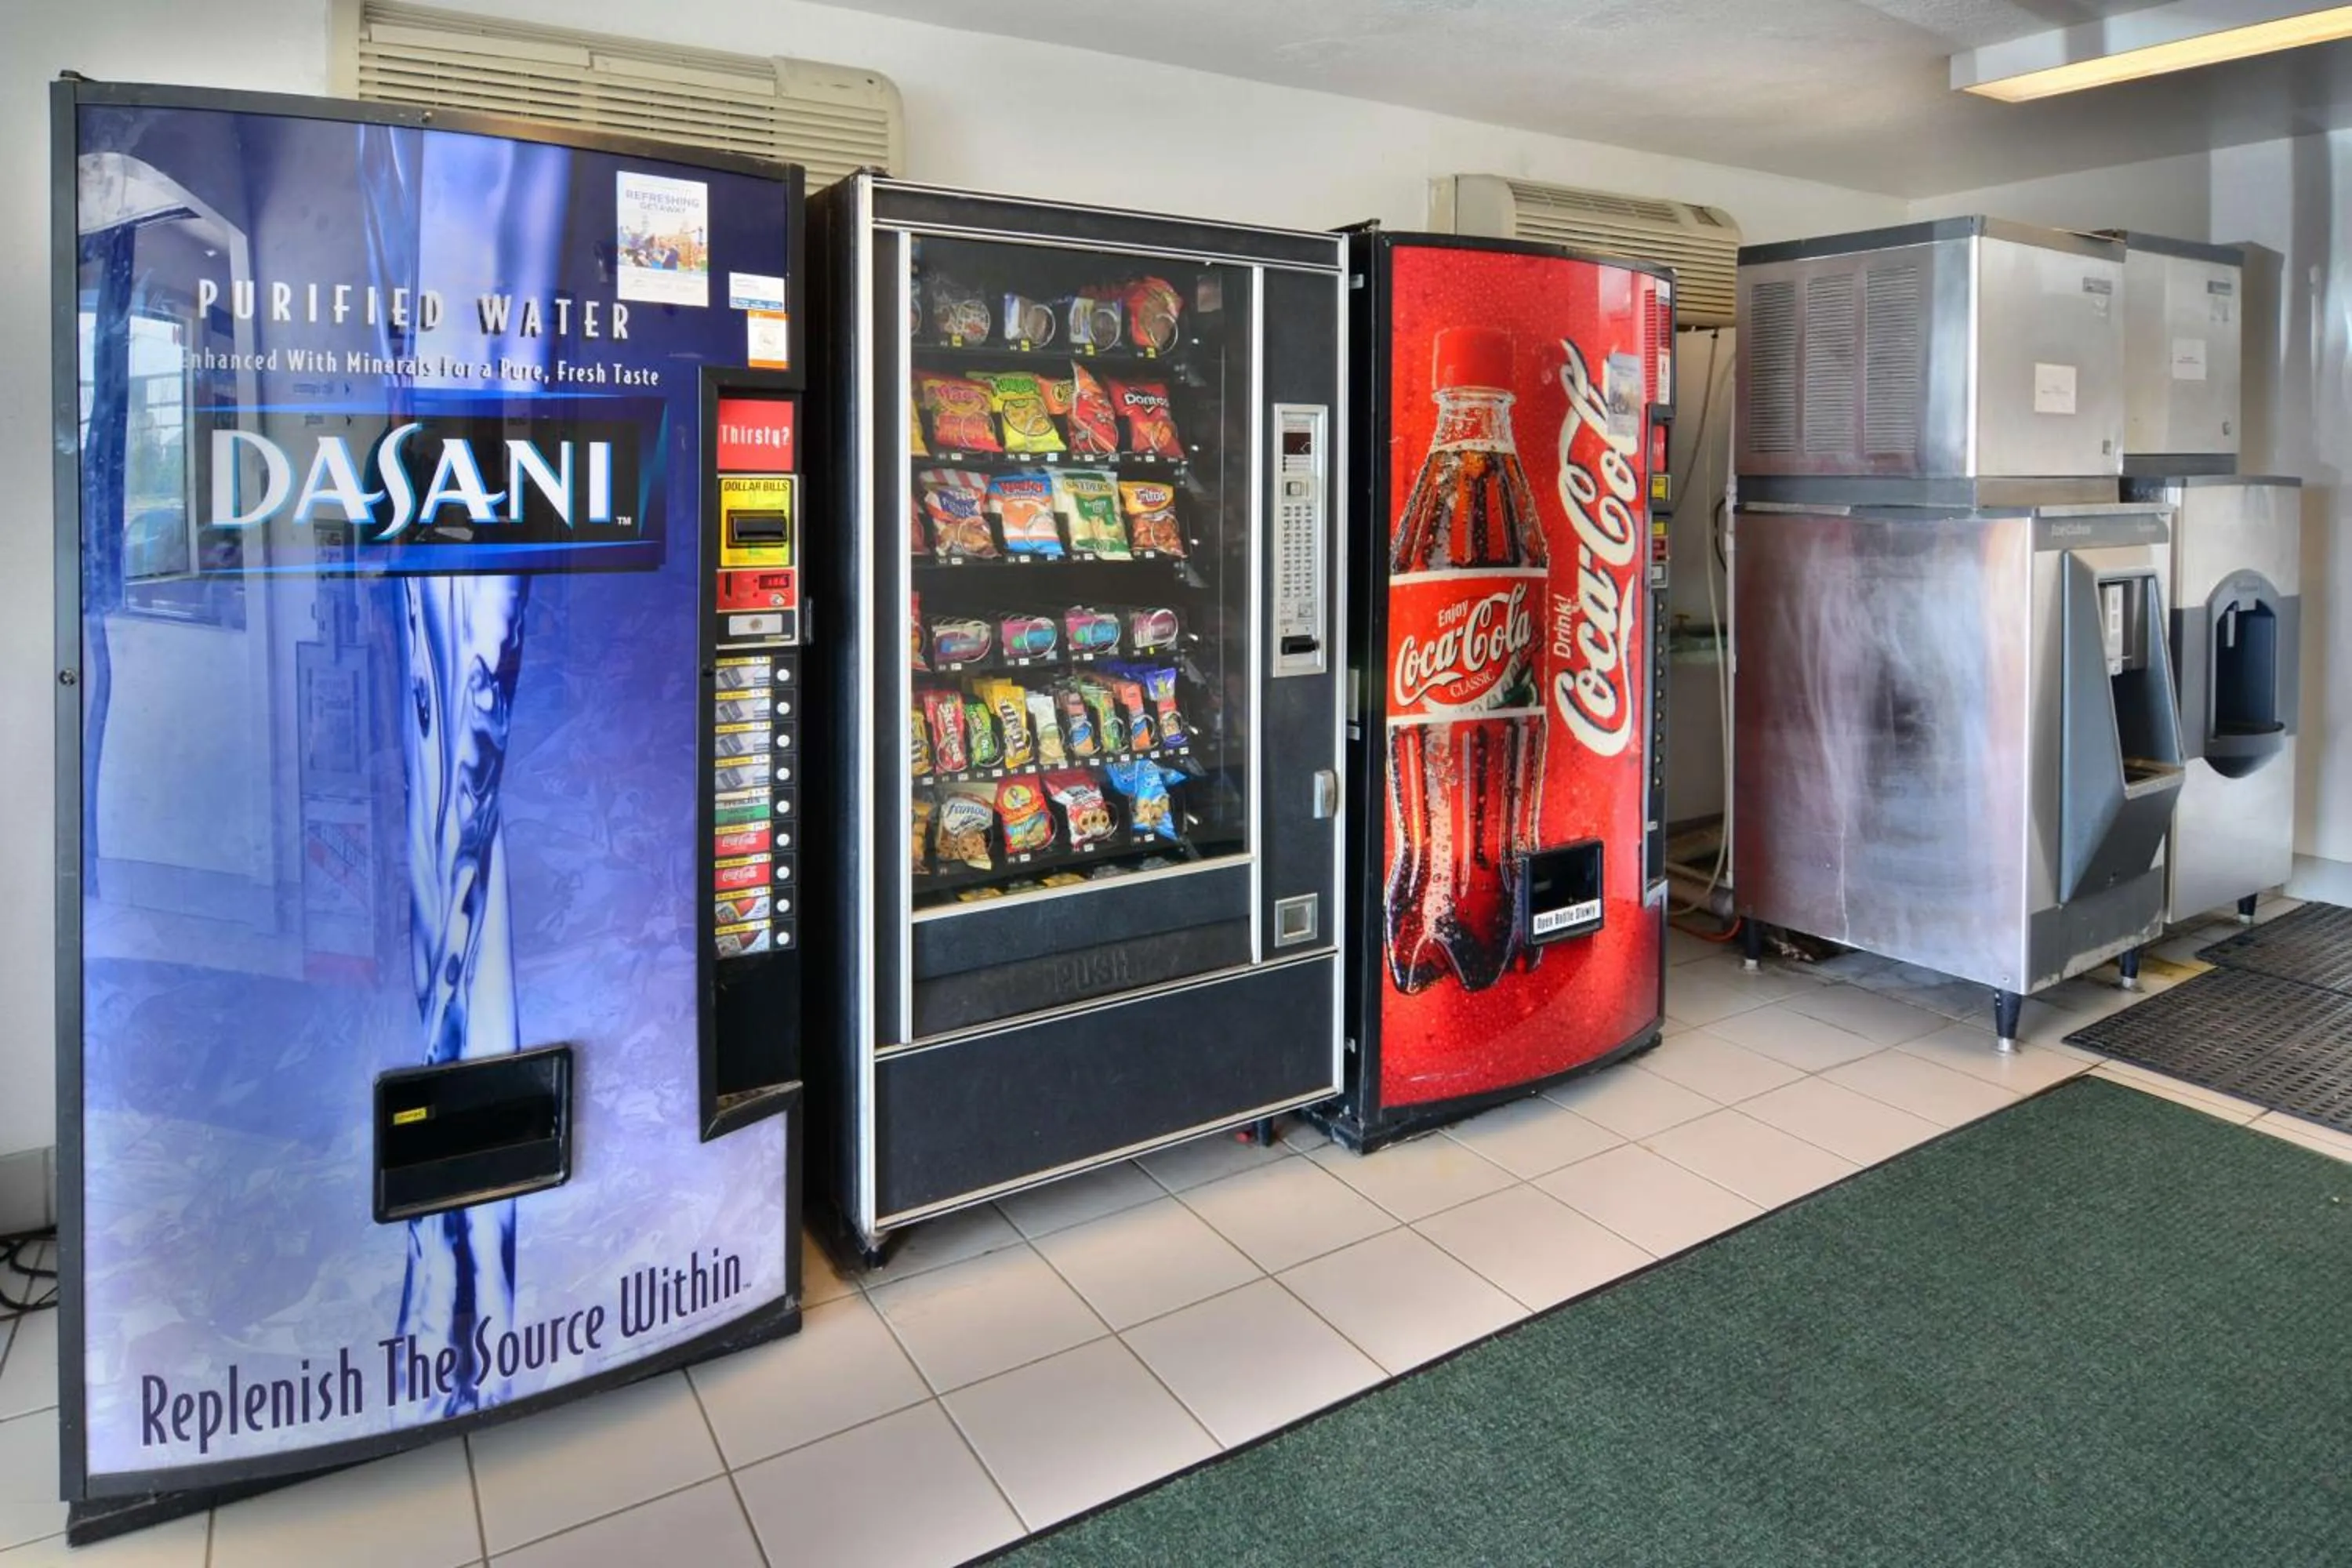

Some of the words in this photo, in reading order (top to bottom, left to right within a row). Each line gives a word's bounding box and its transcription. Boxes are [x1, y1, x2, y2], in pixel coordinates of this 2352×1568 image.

[626, 189, 699, 209] REFRESHING
[640, 202, 686, 214] GETAWAY
[198, 279, 445, 331] PURIFIED
[477, 294, 630, 340] WATER
[181, 347, 278, 372] Enhanced
[287, 348, 338, 373] With
[347, 350, 430, 377] Minerals
[440, 356, 472, 378] For
[481, 362, 492, 379] a
[499, 358, 550, 385] Pure,
[557, 359, 606, 384] Fresh
[613, 363, 660, 387] Taste
[1124, 393, 1170, 408] Doritos
[721, 424, 790, 448] Thirsty?
[212, 421, 614, 542] DASANI
[724, 481, 761, 492] DOLLAR
[763, 481, 788, 492] BILLS
[1554, 337, 1639, 757] Coca-Col
[1437, 601, 1468, 628] Enjoy
[1553, 593, 1572, 659] Drink!
[1394, 582, 1531, 706] Coca-Cola
[1450, 668, 1495, 698] CLASSIC
[141, 1347, 363, 1454] Replenish
[378, 1334, 457, 1406] The
[474, 1301, 605, 1387] Source
[620, 1248, 741, 1338] Within
